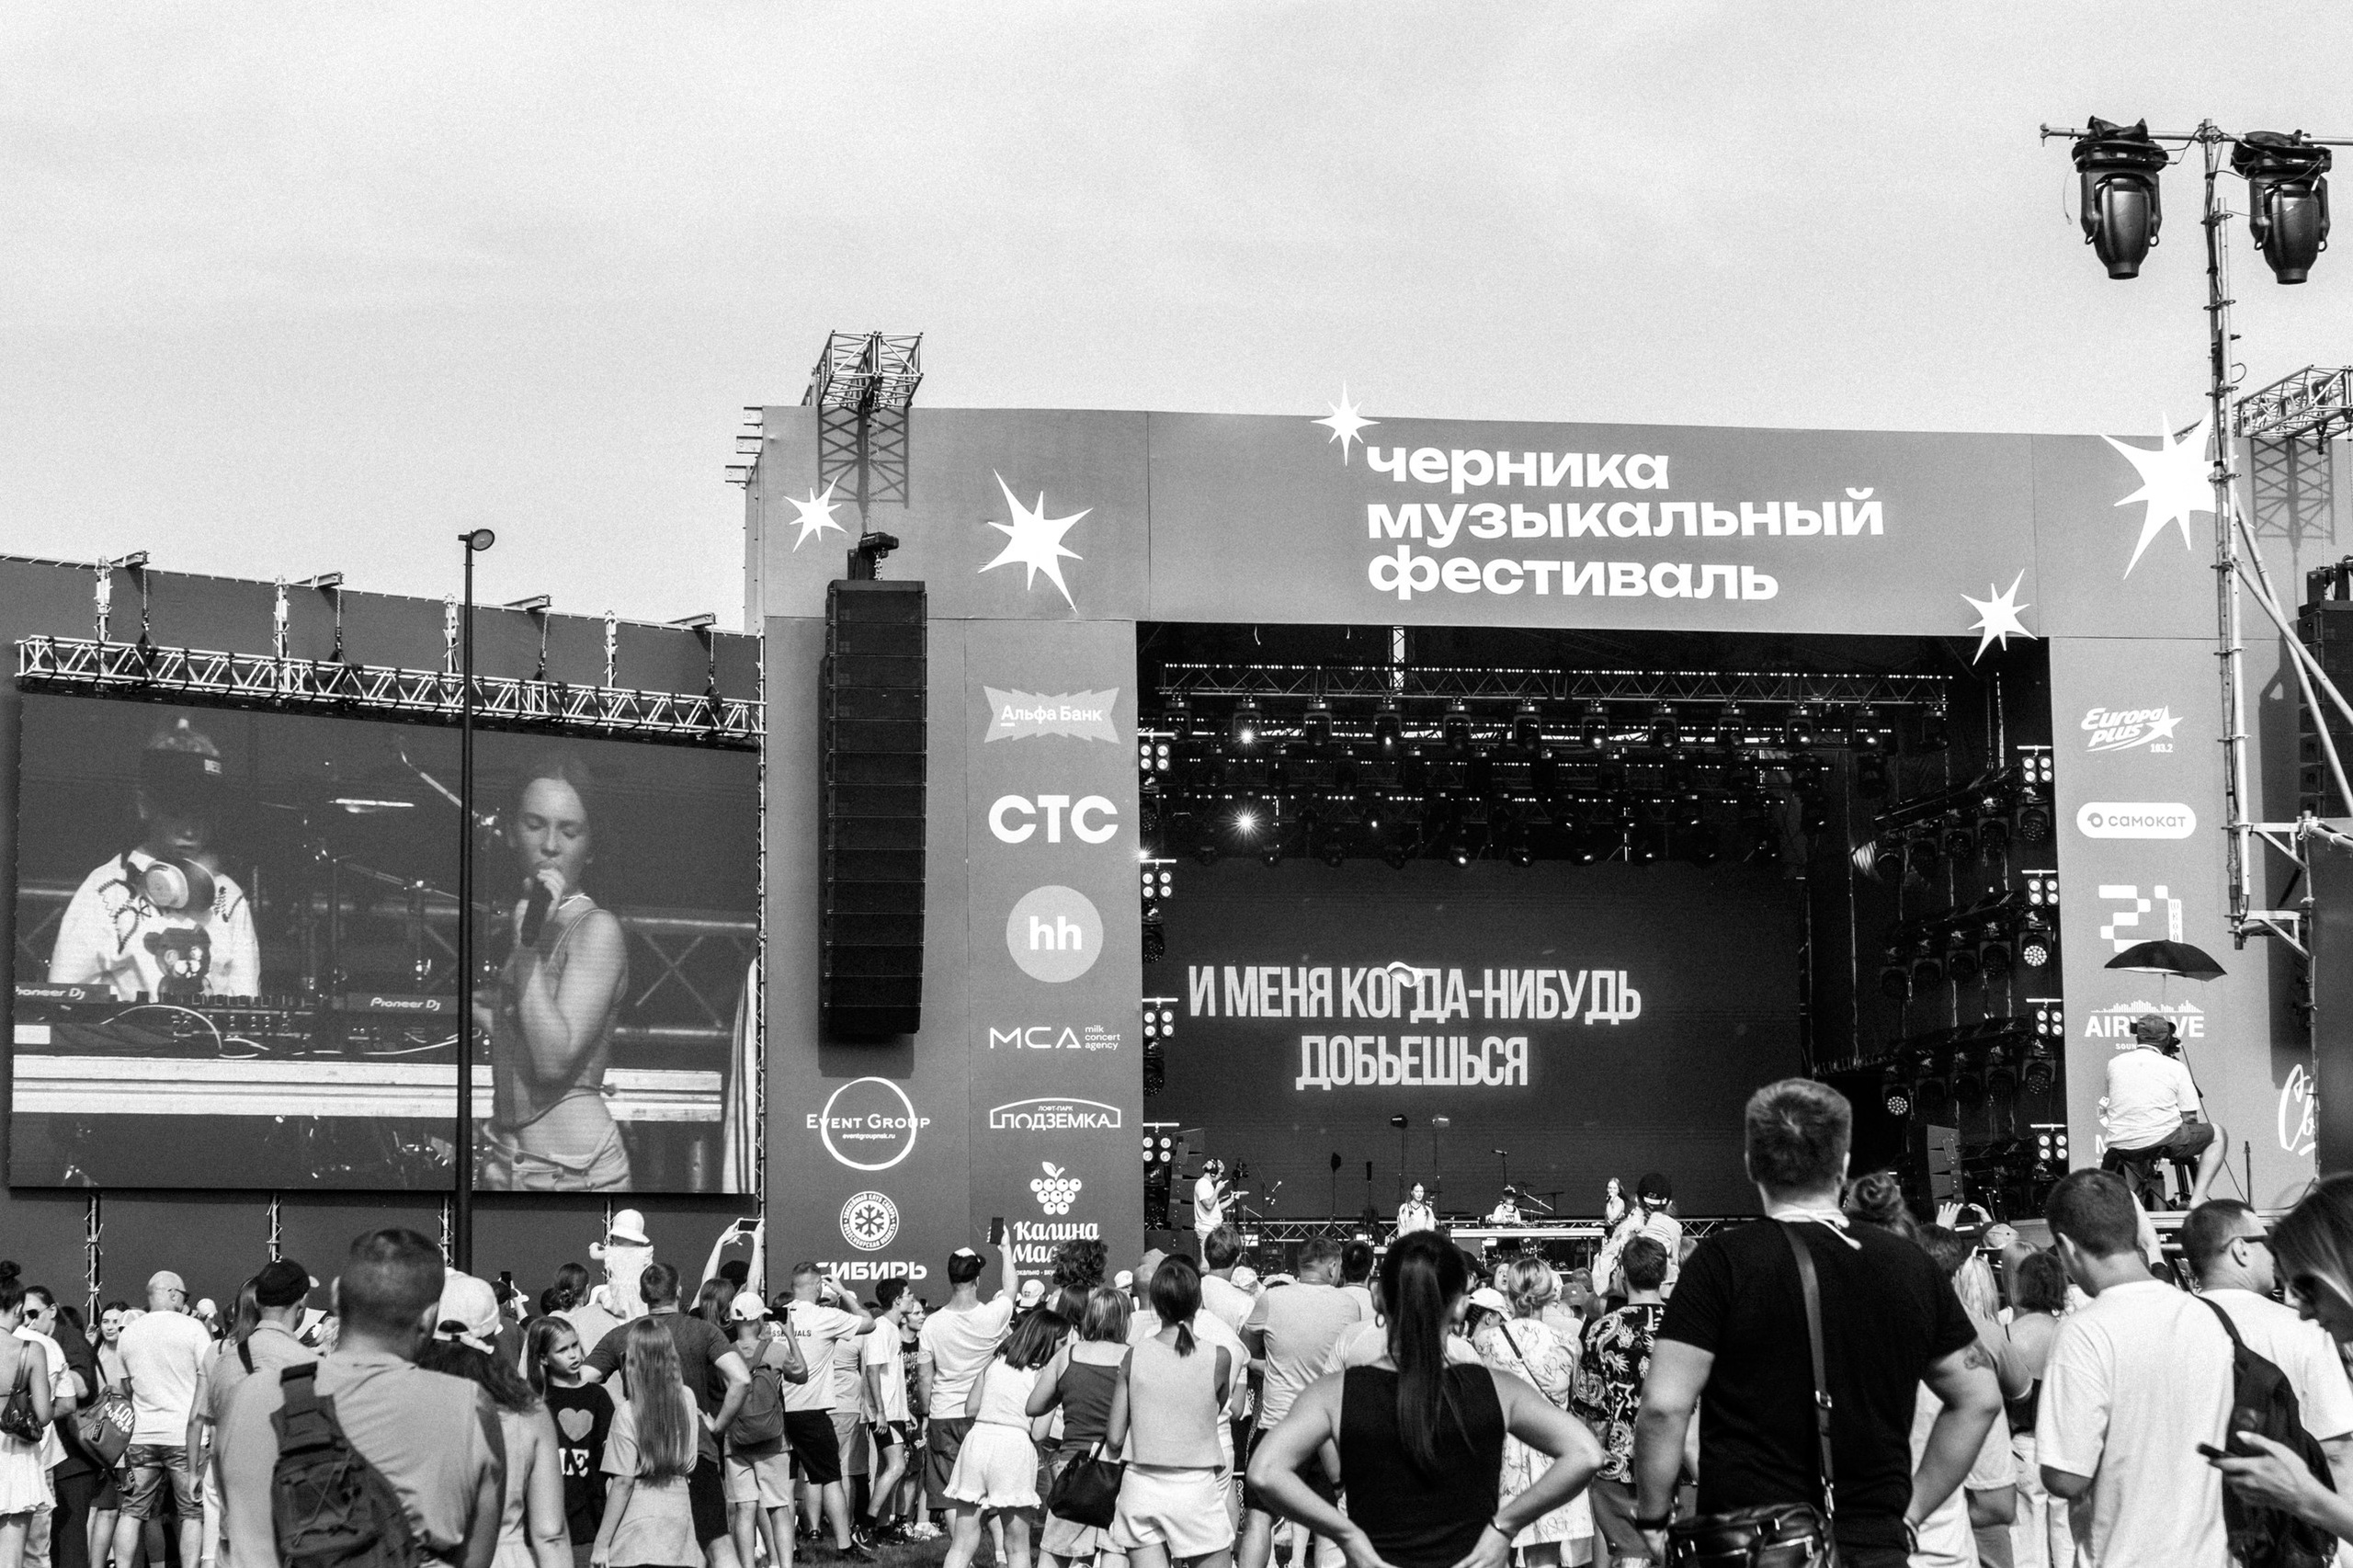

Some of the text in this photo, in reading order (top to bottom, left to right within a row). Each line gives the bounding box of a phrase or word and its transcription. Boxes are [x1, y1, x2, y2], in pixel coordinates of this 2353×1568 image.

[1367, 446, 1669, 494] черника
[1367, 487, 1884, 549] музыкальный
[1368, 545, 1779, 600] фестиваль
[1001, 705, 1103, 726] Альфа Банк
[2151, 743, 2173, 753] 103.2
[988, 794, 1120, 845] СТС
[2108, 815, 2187, 828] самокат
[1029, 915, 1082, 950] hh
[370, 997, 424, 1008] Pioneer
[1188, 965, 1642, 1026] И МЕНЯ КОГДА-НИБУДЬ
[990, 1026, 1082, 1050] MCA
[1085, 1024, 1104, 1033] milk
[2084, 1015, 2205, 1038] AIRVE
[1085, 1042, 1119, 1051] agency
[1295, 1035, 1529, 1091] ДОБЬЕШЬСЯ
[1001, 1113, 1111, 1131] ПОДЗЕМКА
[1013, 1221, 1100, 1242] Калина
